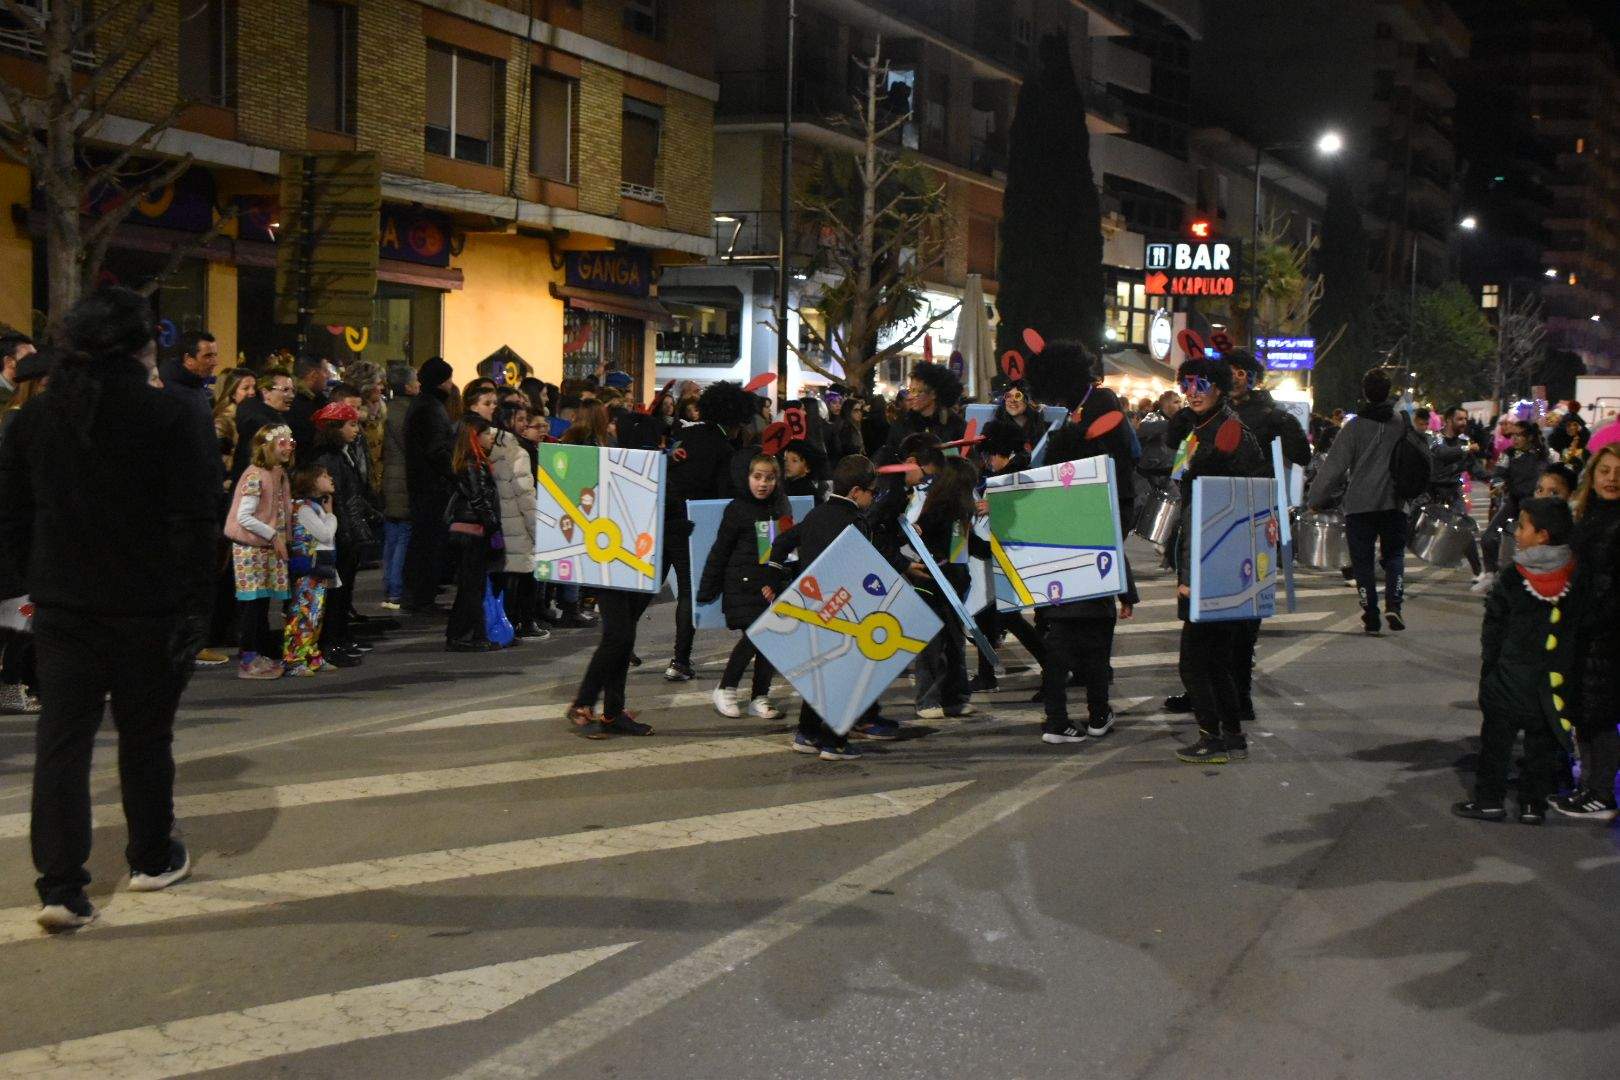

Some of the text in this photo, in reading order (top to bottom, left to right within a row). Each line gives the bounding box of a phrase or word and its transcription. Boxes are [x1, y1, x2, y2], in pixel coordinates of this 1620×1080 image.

[1174, 243, 1231, 270] BAR
[576, 253, 640, 286] GANGA
[1170, 276, 1234, 296] ACAPULCO
[1183, 332, 1205, 358] A
[1007, 354, 1021, 376] A
[786, 411, 804, 435] B
[1100, 555, 1109, 570] P
